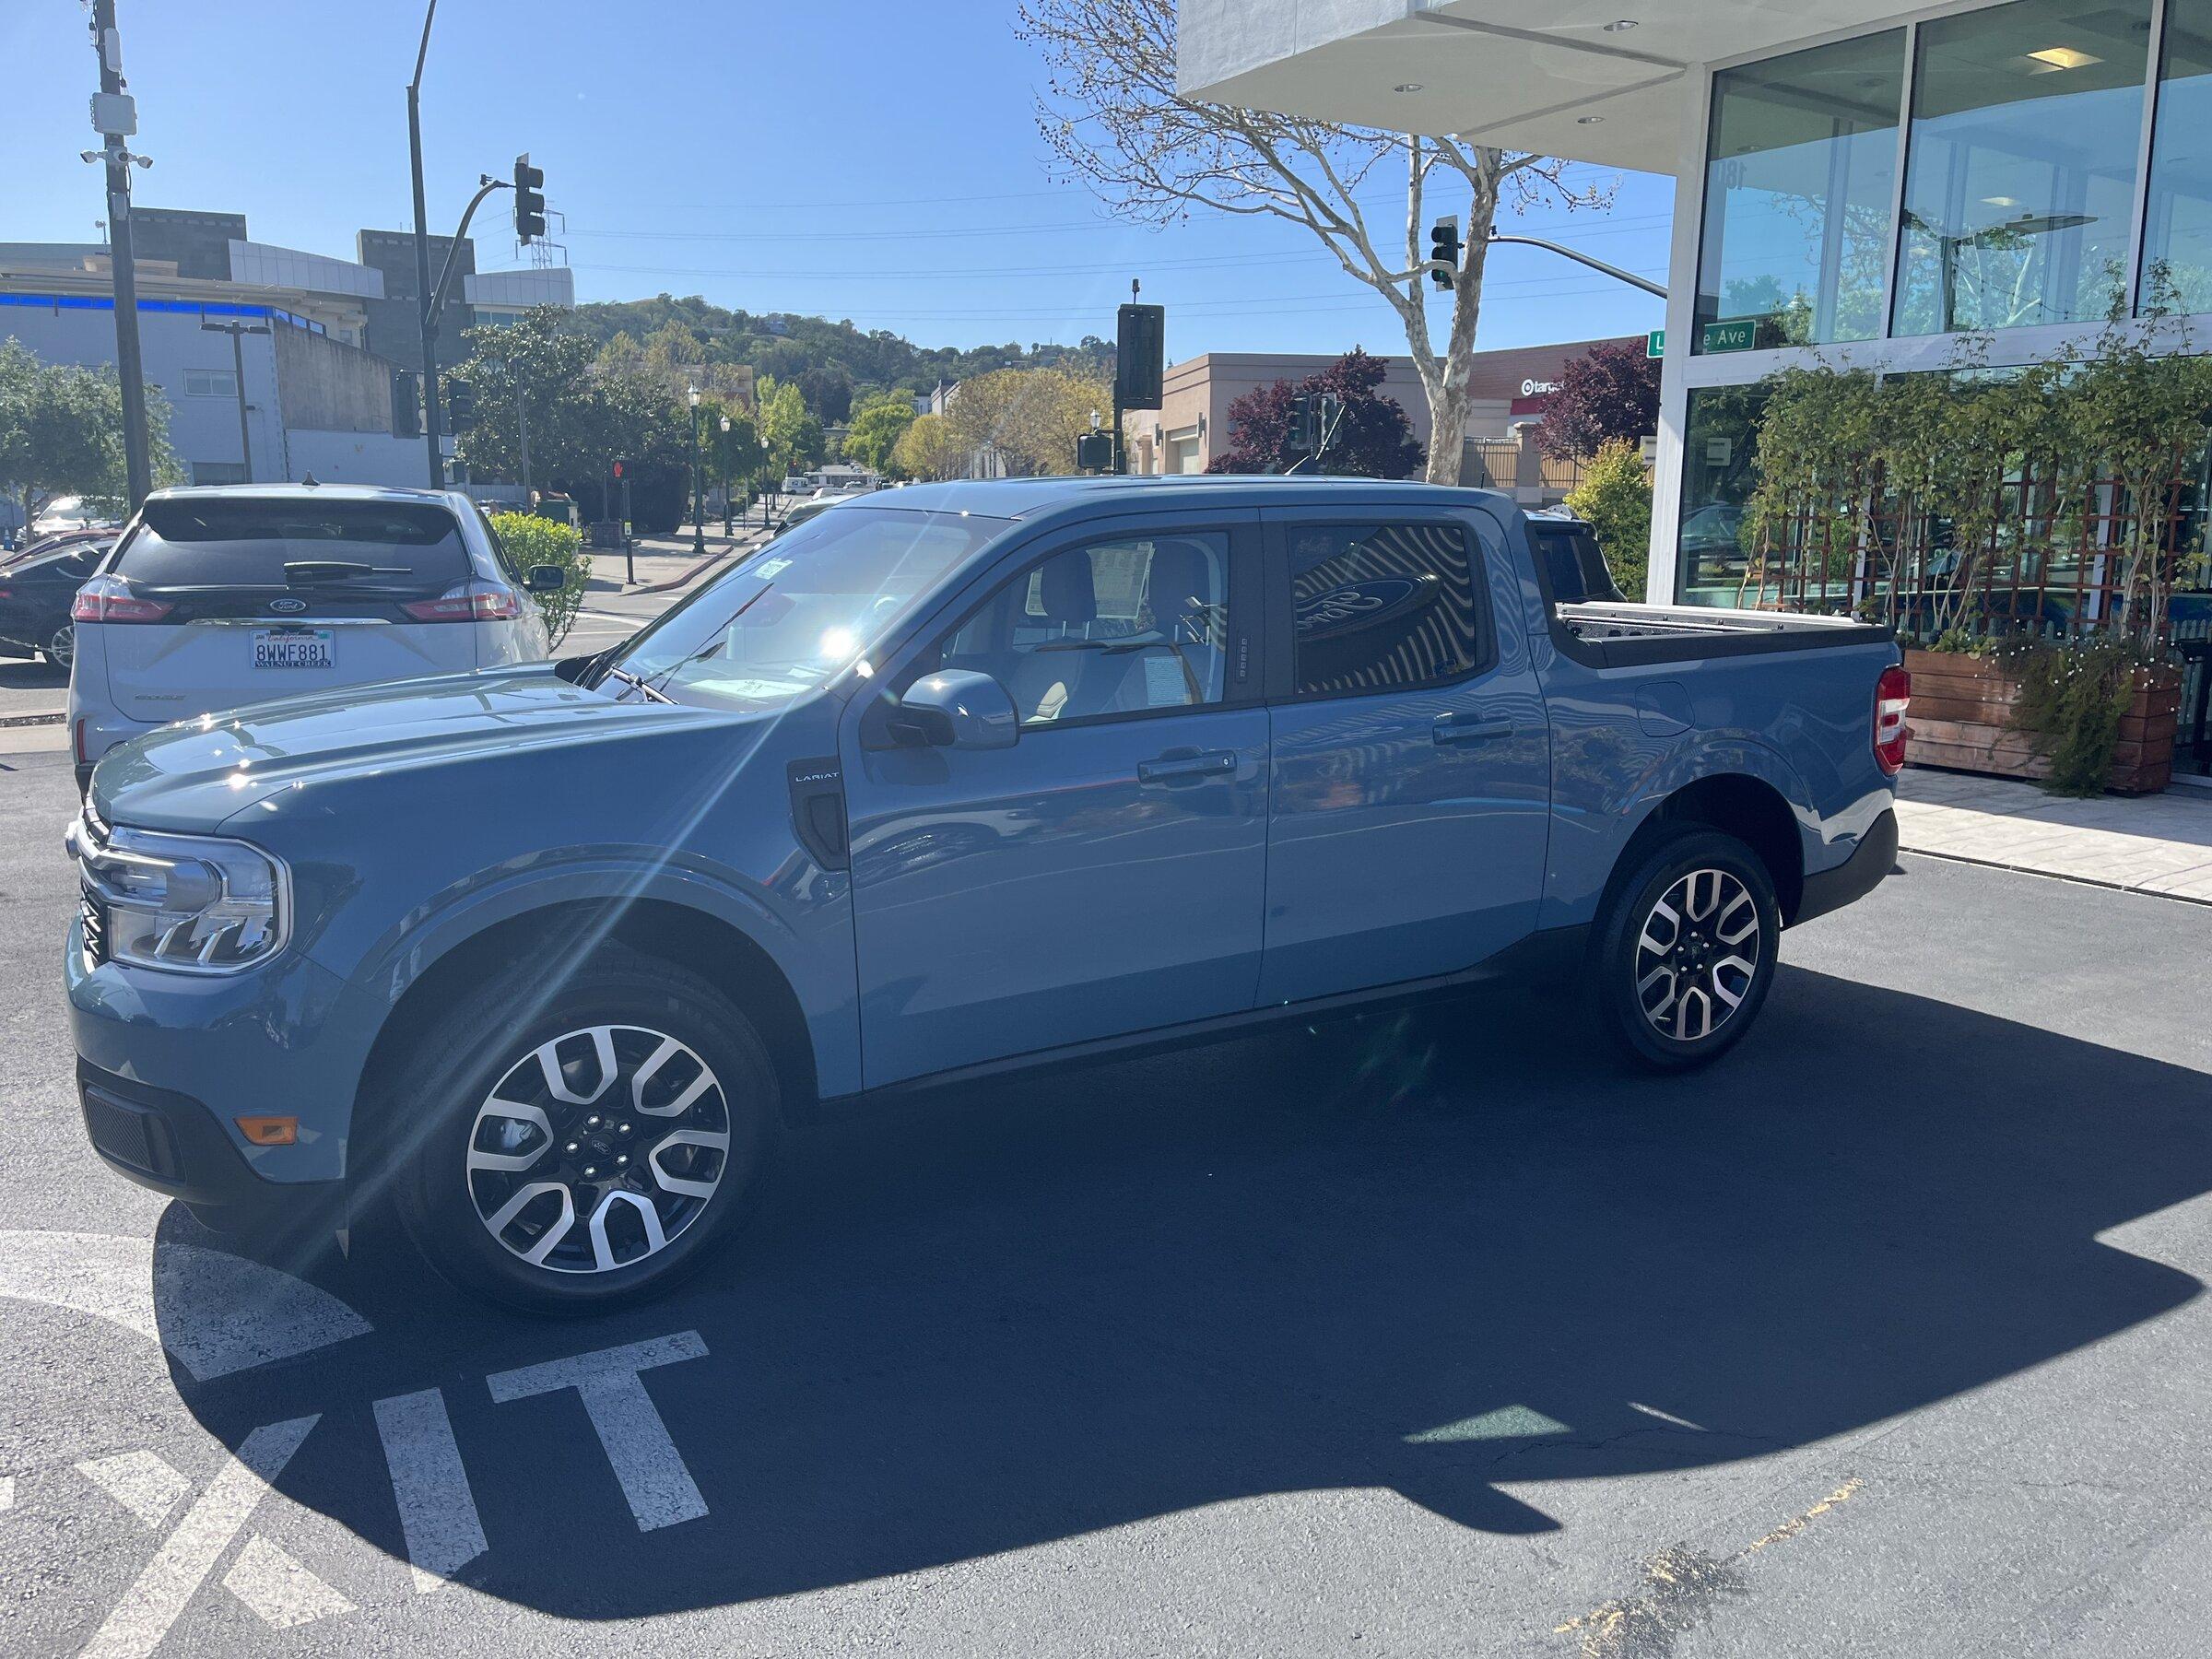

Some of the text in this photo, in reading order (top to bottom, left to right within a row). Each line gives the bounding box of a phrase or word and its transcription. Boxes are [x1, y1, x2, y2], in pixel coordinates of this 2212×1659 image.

[1717, 330, 1746, 345] Ave
[256, 644, 326, 661] 8WWF881
[795, 771, 840, 782] LARIAT
[0, 1329, 710, 1659] XIT
